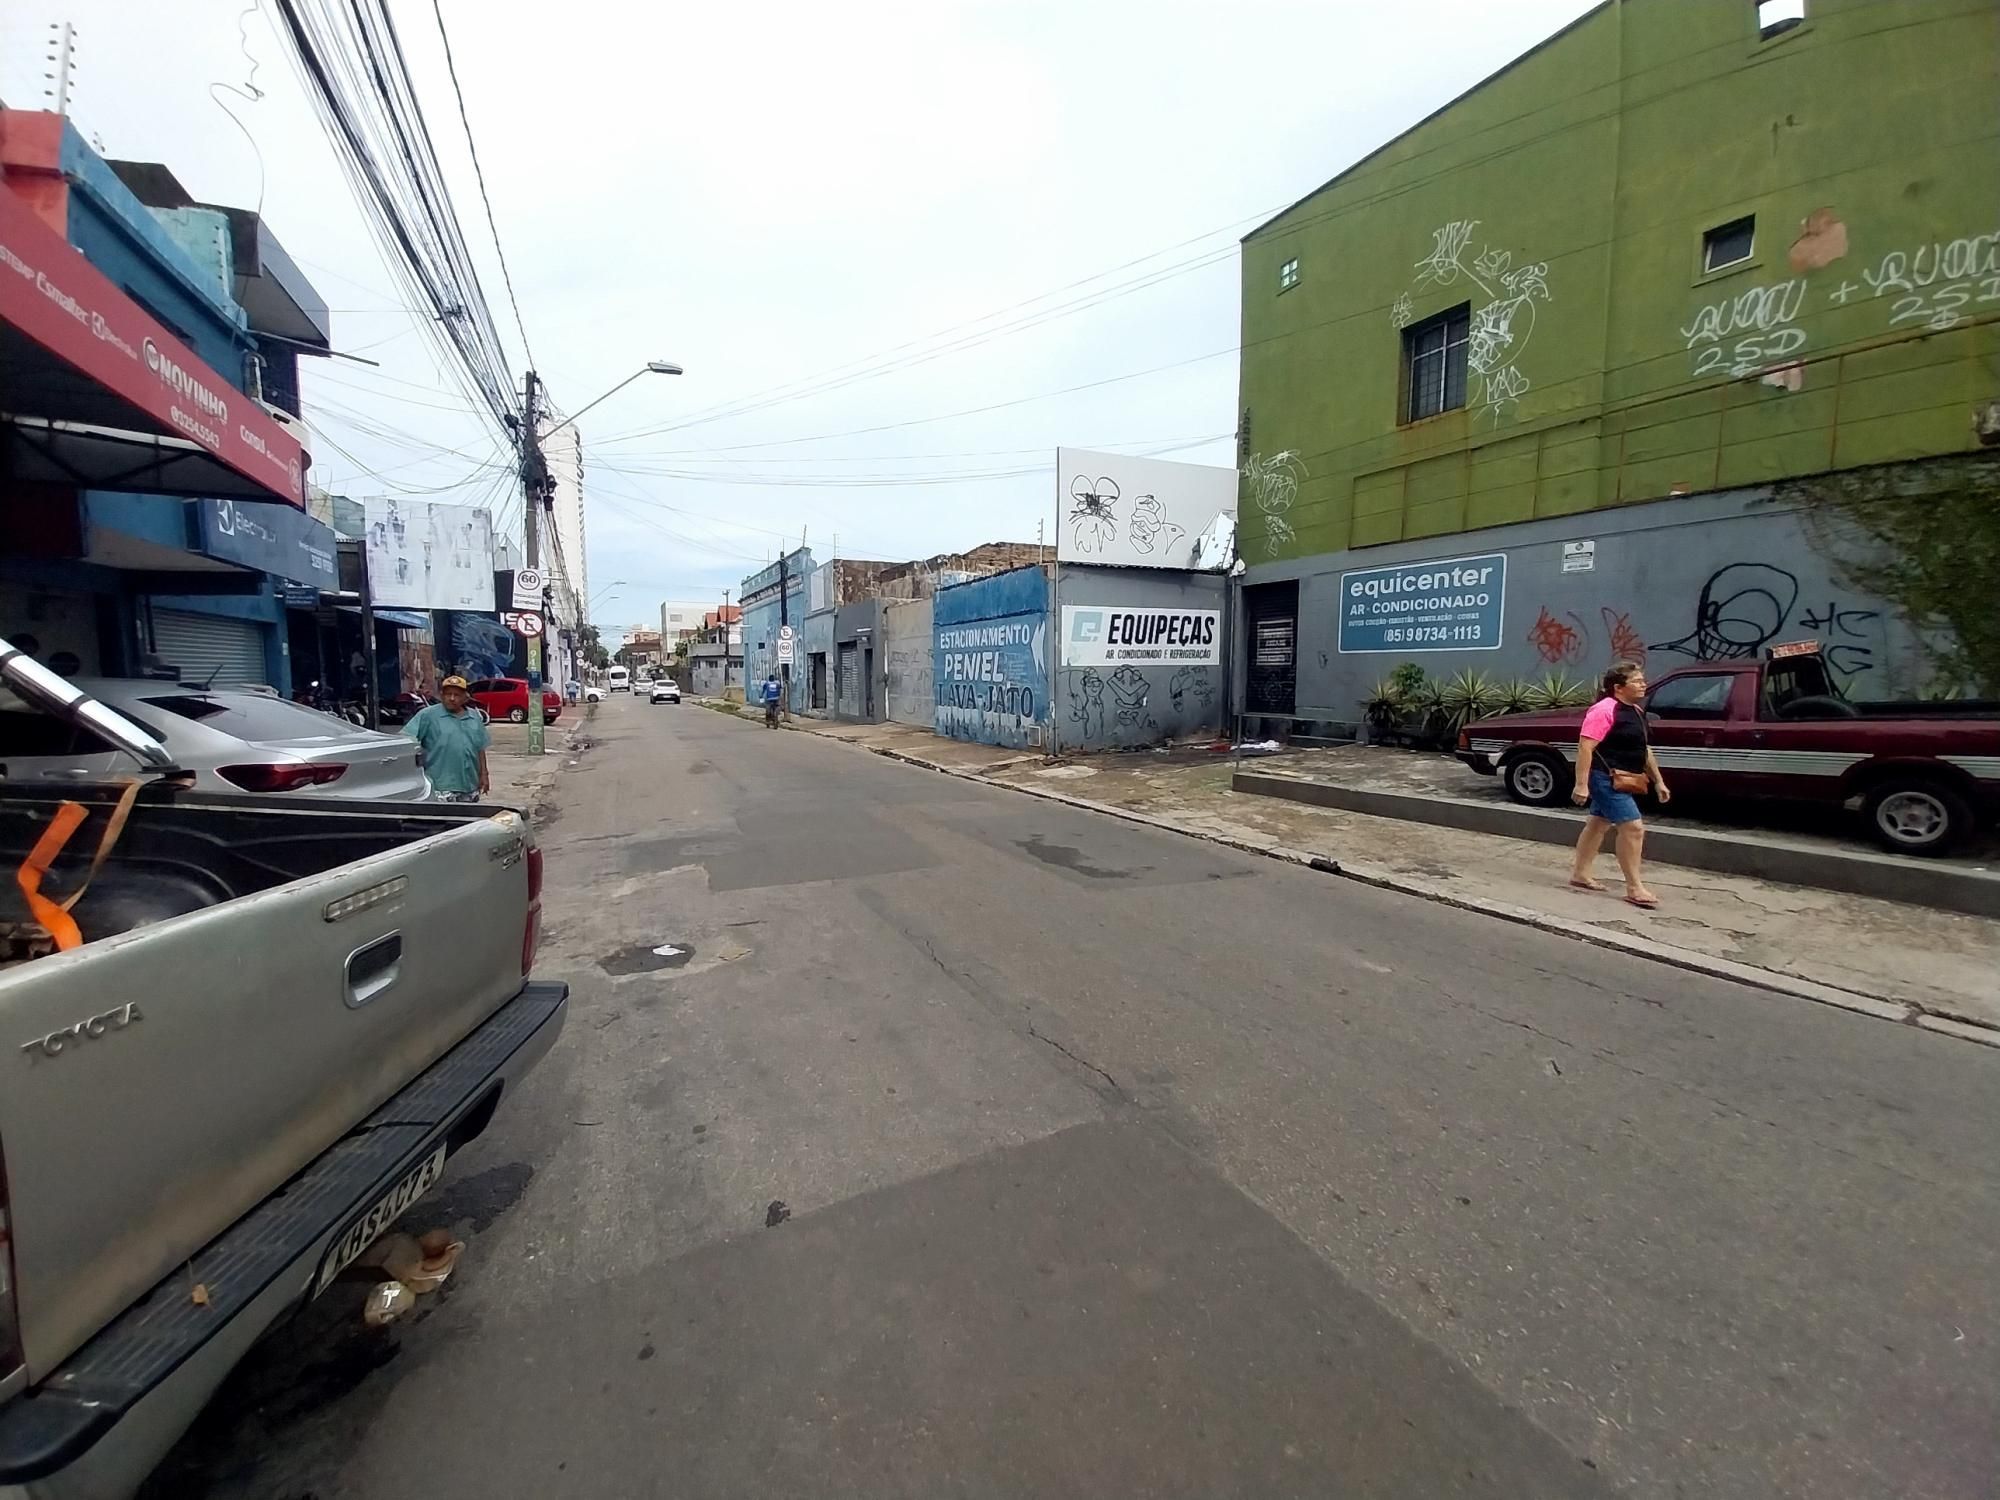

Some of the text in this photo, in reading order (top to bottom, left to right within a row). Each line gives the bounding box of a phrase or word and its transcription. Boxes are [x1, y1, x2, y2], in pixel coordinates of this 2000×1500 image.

[521, 574, 537, 584] 60
[1350, 566, 1493, 598] equicenter
[940, 624, 1030, 649] ESTACIONAMENTO
[1107, 614, 1215, 646] EQUIPEÇAS
[944, 651, 1004, 682] PENIEL
[1105, 648, 1211, 660] AR CONDICIONADO E REFRIGERAÇÃO
[937, 684, 1034, 718] LAVA-JATO
[19, 1000, 143, 1066] TOYOTA
